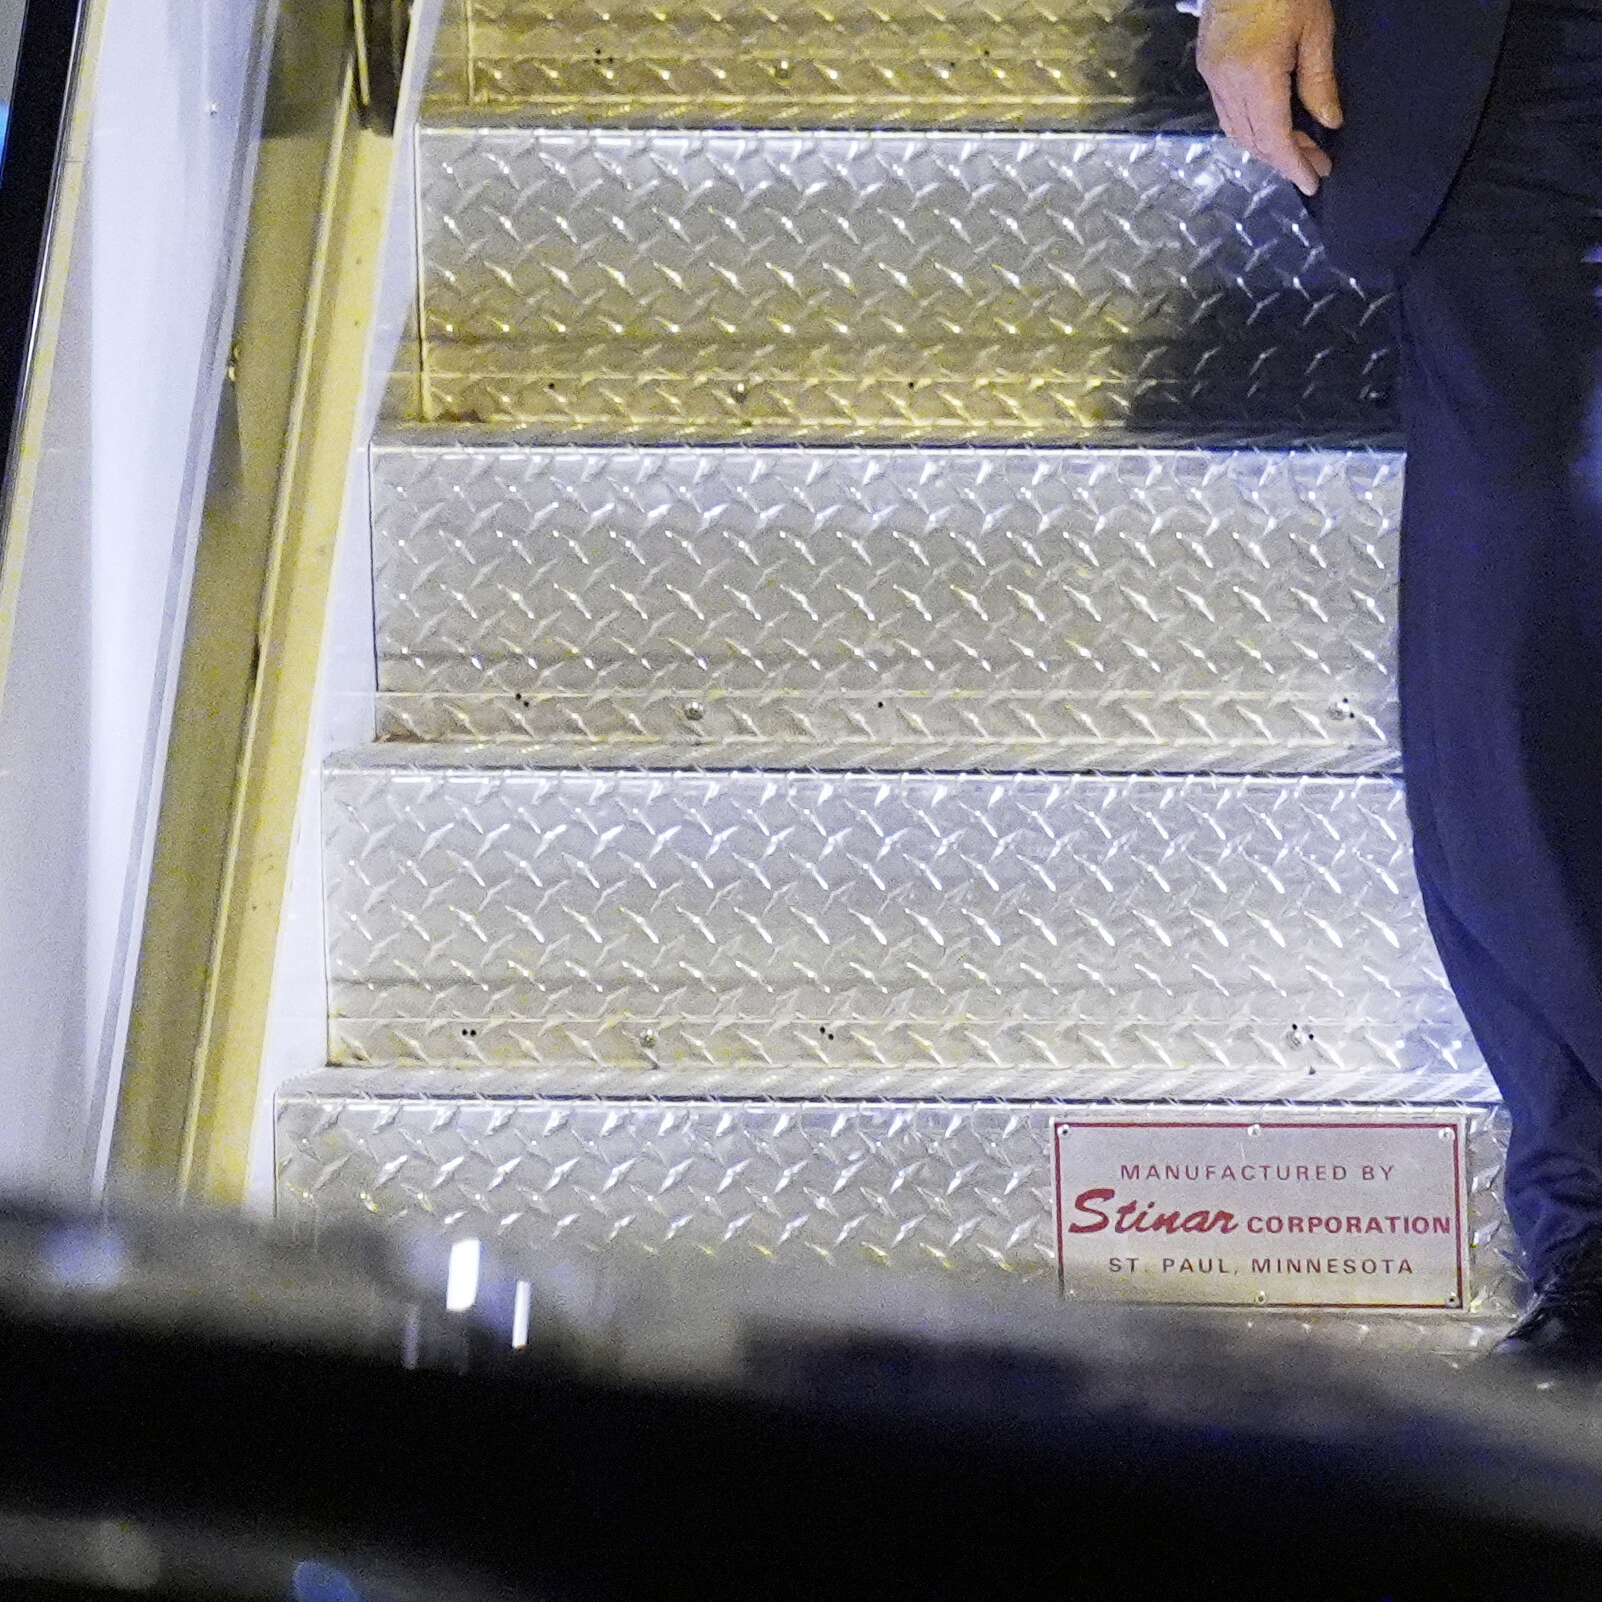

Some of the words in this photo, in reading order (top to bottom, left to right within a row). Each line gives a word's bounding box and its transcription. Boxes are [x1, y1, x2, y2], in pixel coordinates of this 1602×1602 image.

[1119, 1163, 1349, 1182] MANUFACTURED
[1360, 1163, 1395, 1182] BY
[1066, 1186, 1240, 1236] Stinar
[1245, 1214, 1452, 1236] CORPORATION
[1250, 1256, 1415, 1276] MINNESOTA
